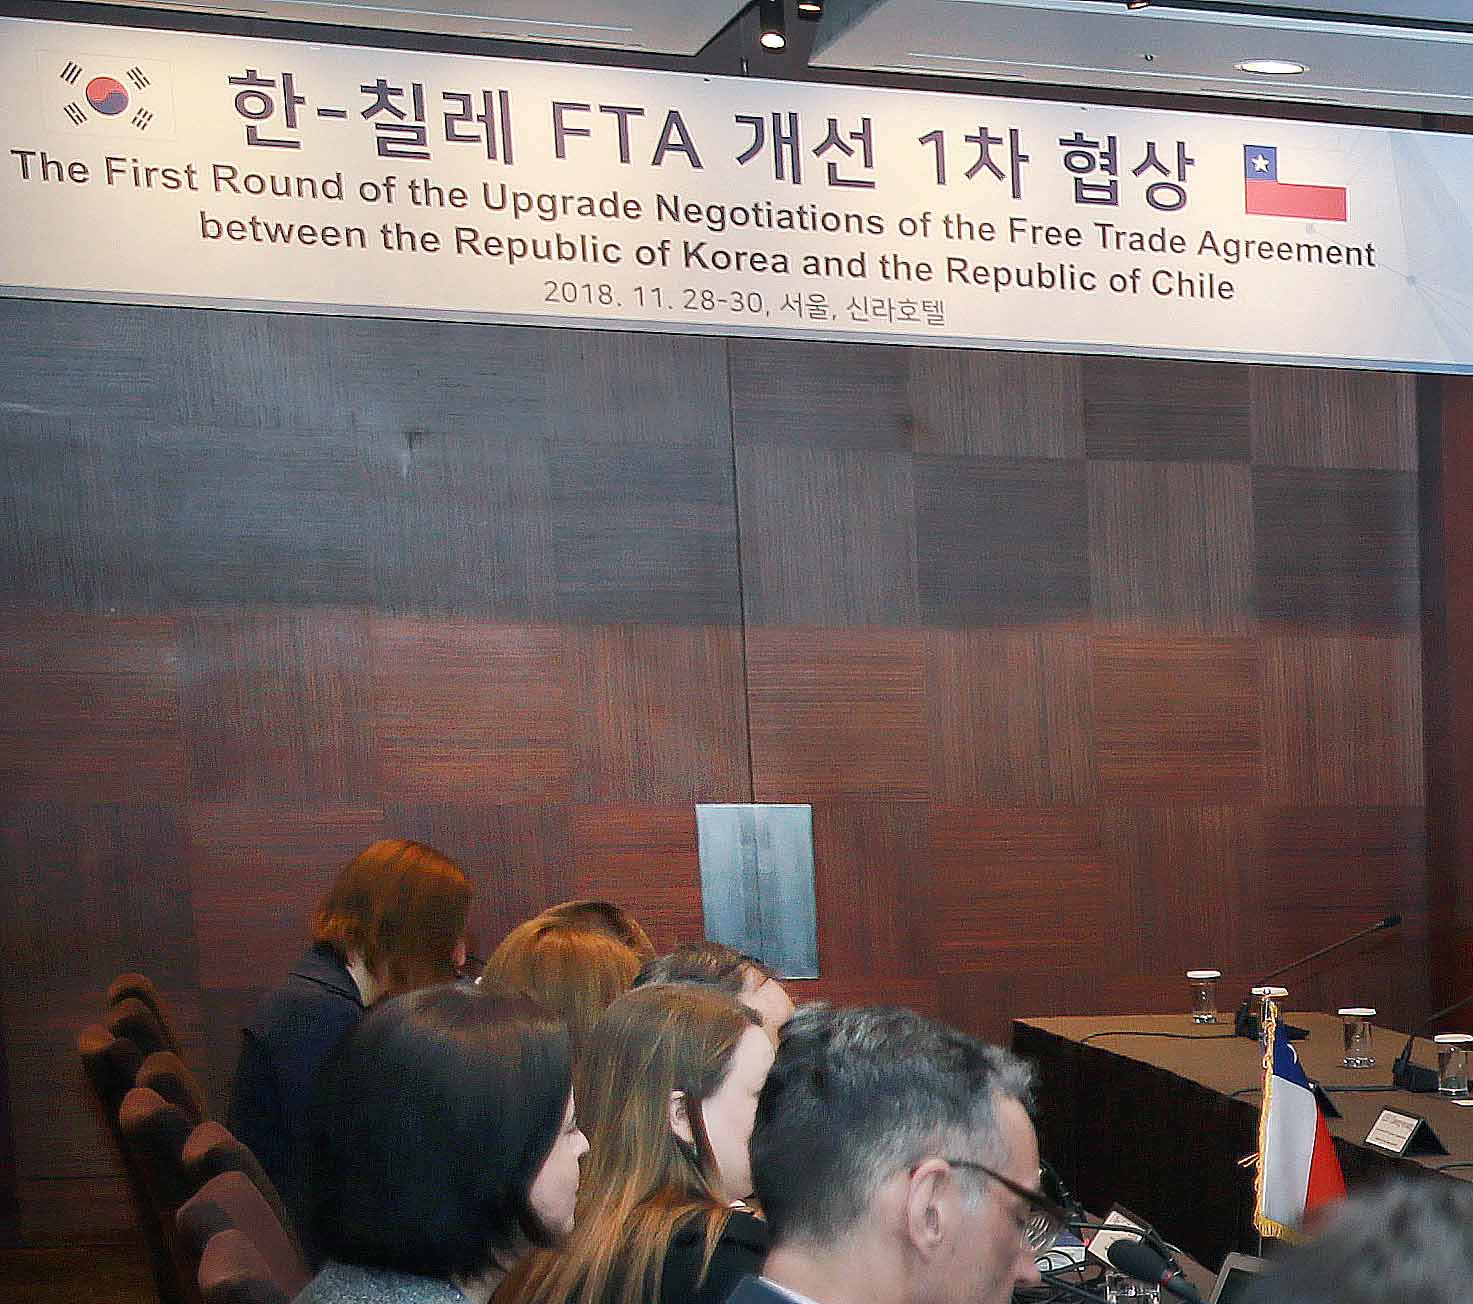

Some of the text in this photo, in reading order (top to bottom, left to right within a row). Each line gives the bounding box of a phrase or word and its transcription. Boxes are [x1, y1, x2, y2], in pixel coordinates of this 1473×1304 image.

[227, 67, 1195, 211] 한-칠레 FTA 개선 1차 협상
[10, 147, 1376, 270] The First Round of the Upgrade Negotiations of the Free Trade Agreement
[200, 210, 1234, 300] between the Republic of Korea and the Republic of Chile
[544, 281, 944, 326] 2018. 11. 28-30, 서울, 신라호텔
